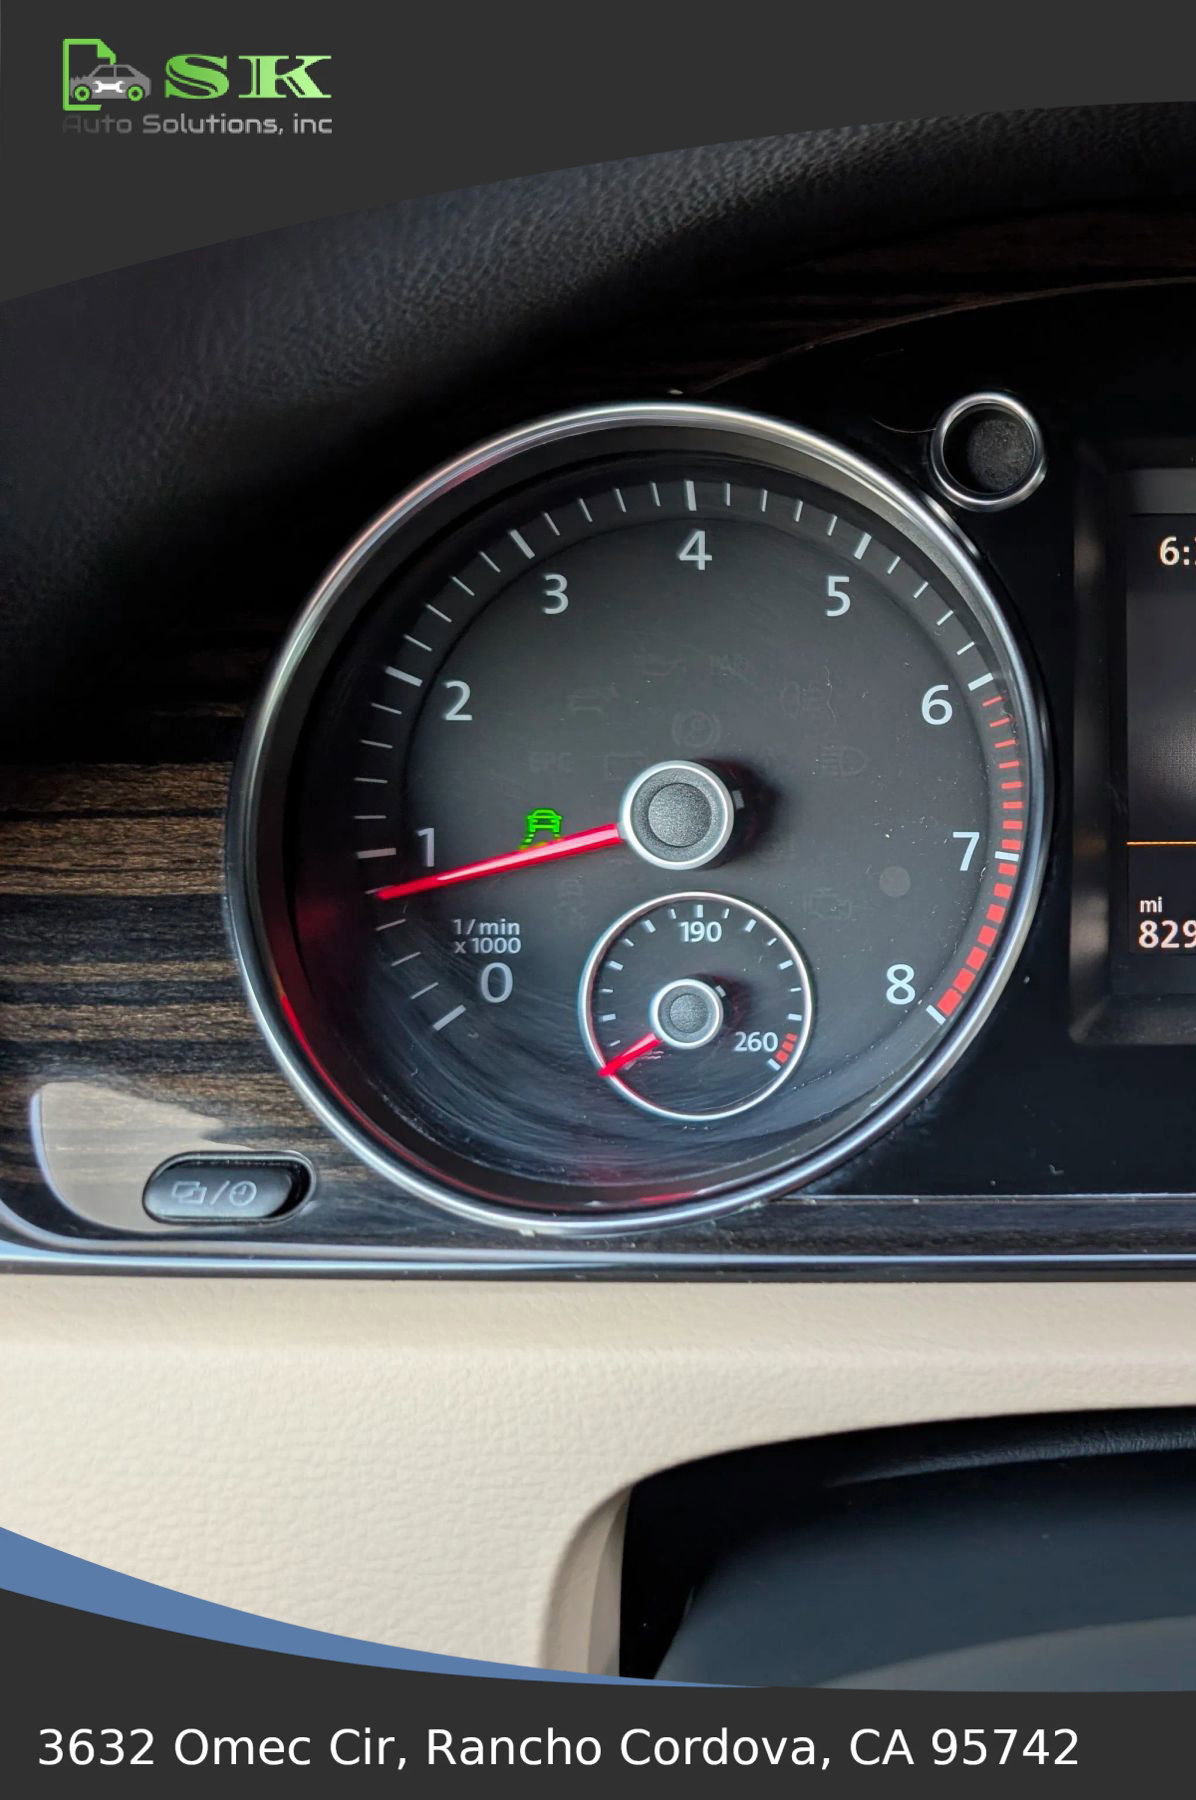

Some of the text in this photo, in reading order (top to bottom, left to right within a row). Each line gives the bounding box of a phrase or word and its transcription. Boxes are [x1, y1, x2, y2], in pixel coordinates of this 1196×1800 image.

[678, 530, 713, 571] 4
[544, 573, 569, 615] 3
[826, 575, 851, 617] 5
[444, 680, 473, 721] 2
[921, 684, 953, 726] 6
[417, 827, 435, 868] 1
[952, 831, 980, 872] 7
[1140, 896, 1163, 913] mi
[454, 918, 521, 937] 1/min
[471, 937, 522, 954] 1000
[680, 921, 722, 943] 190
[480, 962, 513, 1003] 0
[886, 963, 916, 1005] 8
[734, 1031, 779, 1053] 260
